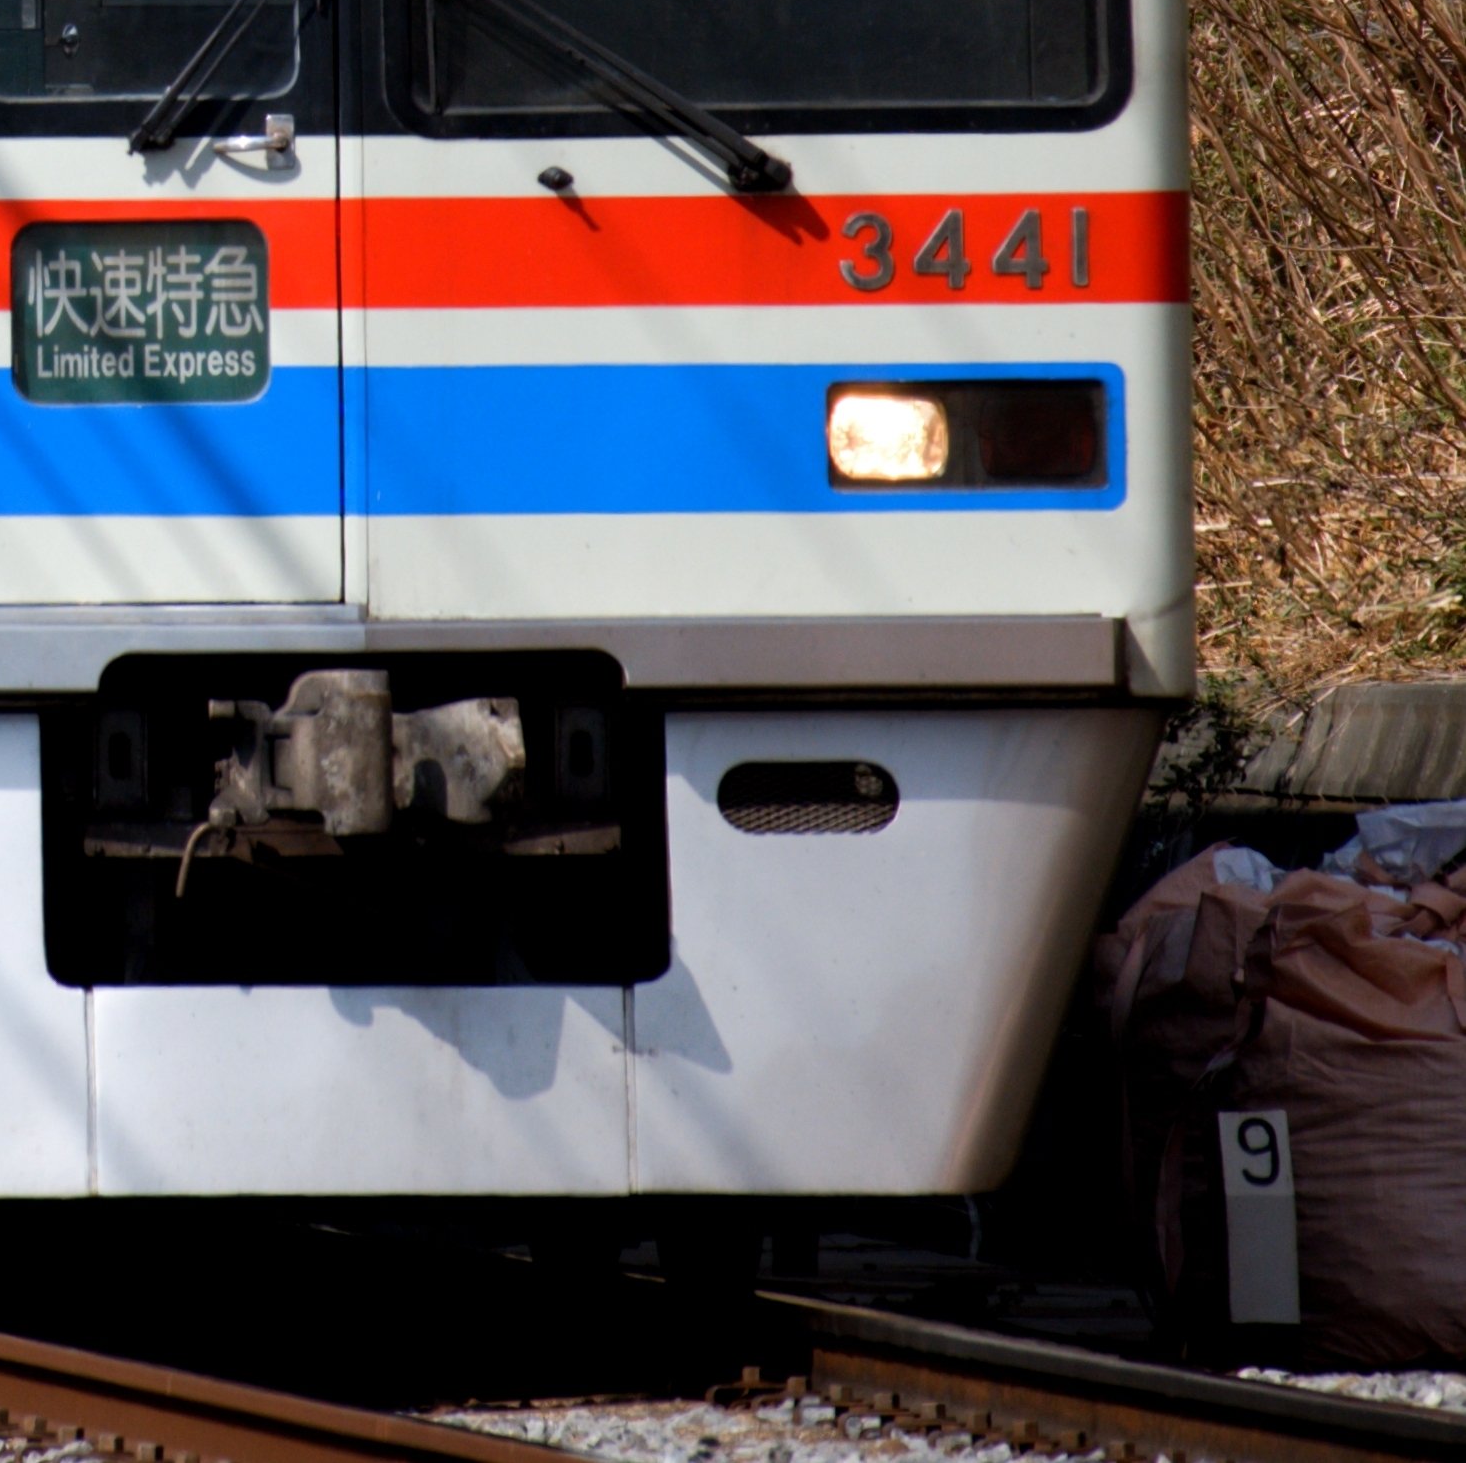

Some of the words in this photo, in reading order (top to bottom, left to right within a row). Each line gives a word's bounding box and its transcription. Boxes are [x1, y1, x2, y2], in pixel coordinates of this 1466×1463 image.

[839, 206, 1090, 292] 3441
[27, 244, 265, 341] 快速特急
[37, 344, 135, 380] Limited
[144, 343, 257, 384] Express
[1237, 1117, 1280, 1188] 9
